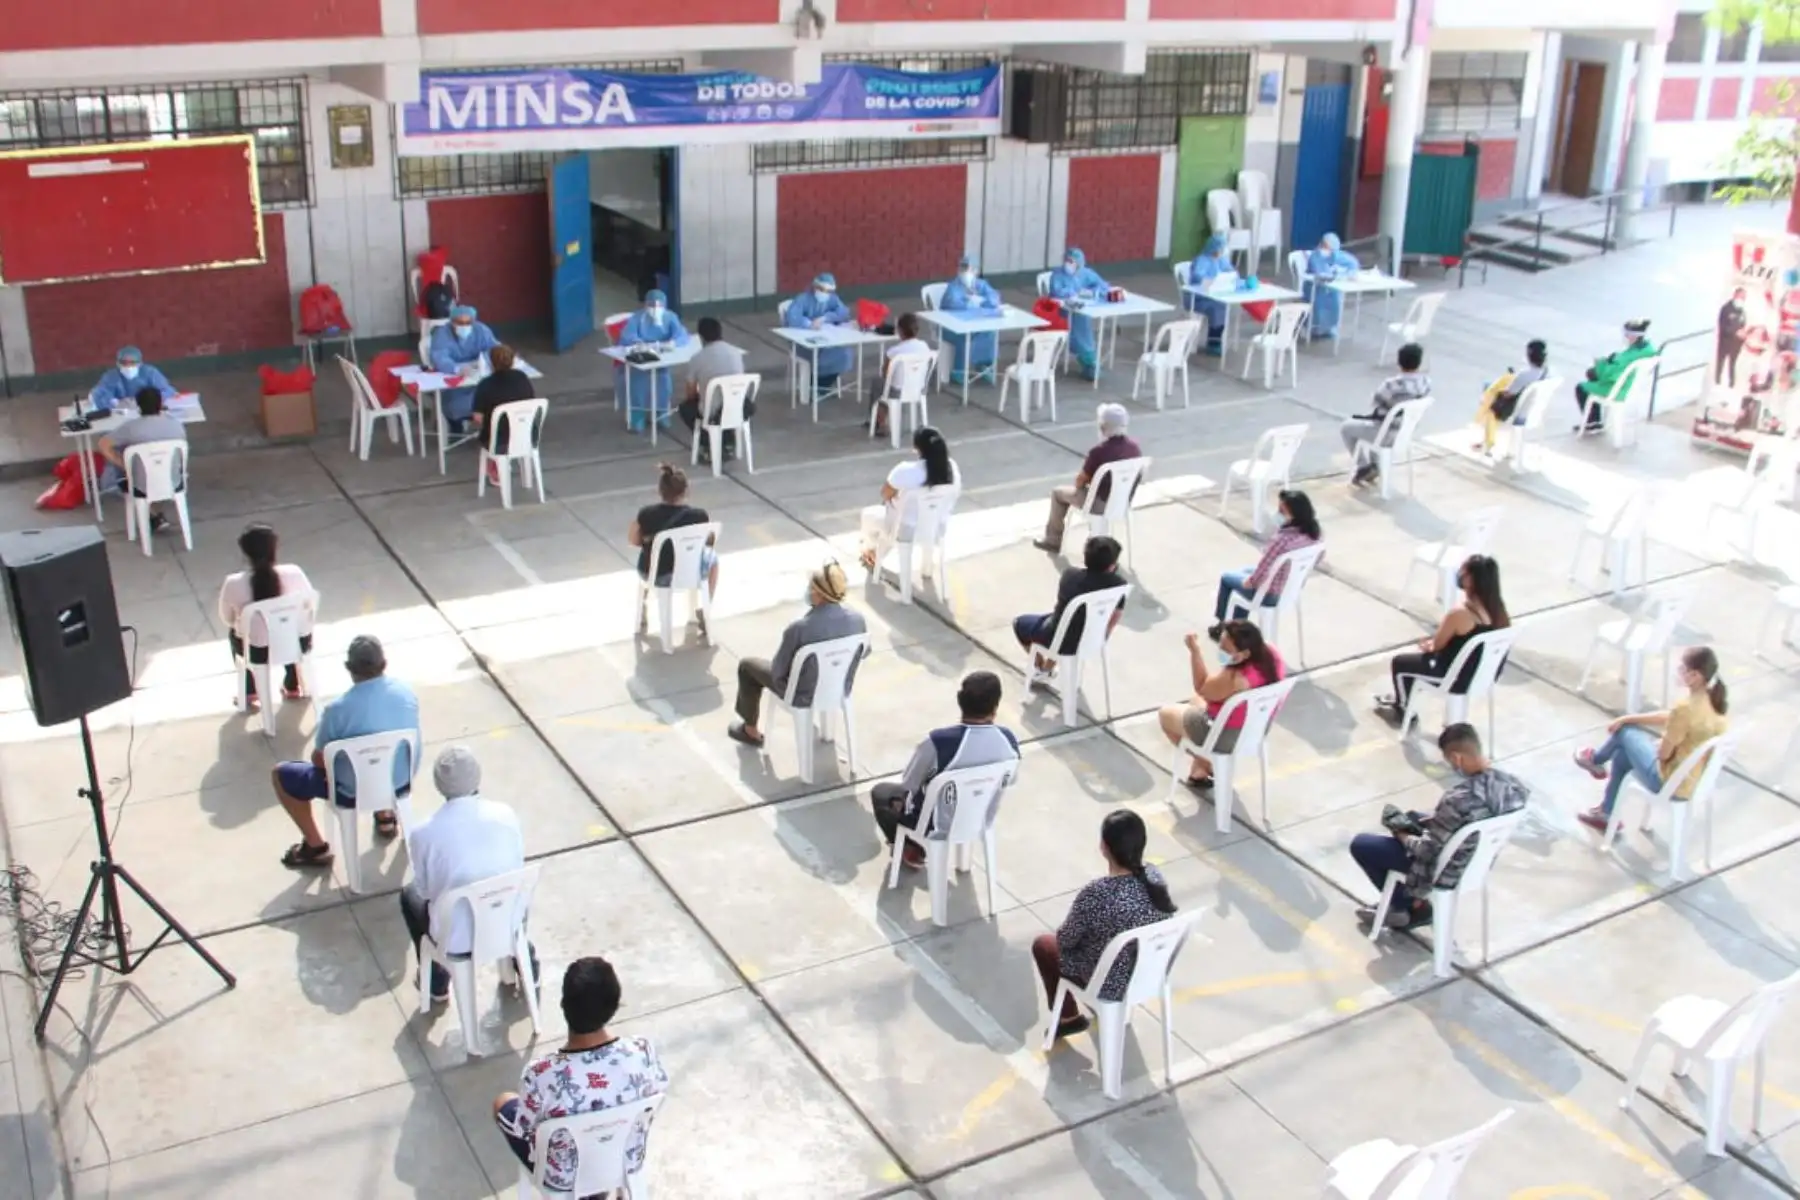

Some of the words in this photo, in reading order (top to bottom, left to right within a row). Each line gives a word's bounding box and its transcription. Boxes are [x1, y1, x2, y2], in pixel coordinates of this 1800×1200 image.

[697, 84, 726, 101] DE
[730, 82, 806, 99] TODOS
[429, 81, 637, 130] MINSA
[865, 96, 886, 109] DE
[888, 97, 911, 110] LA
[914, 95, 980, 109] COVID-19
